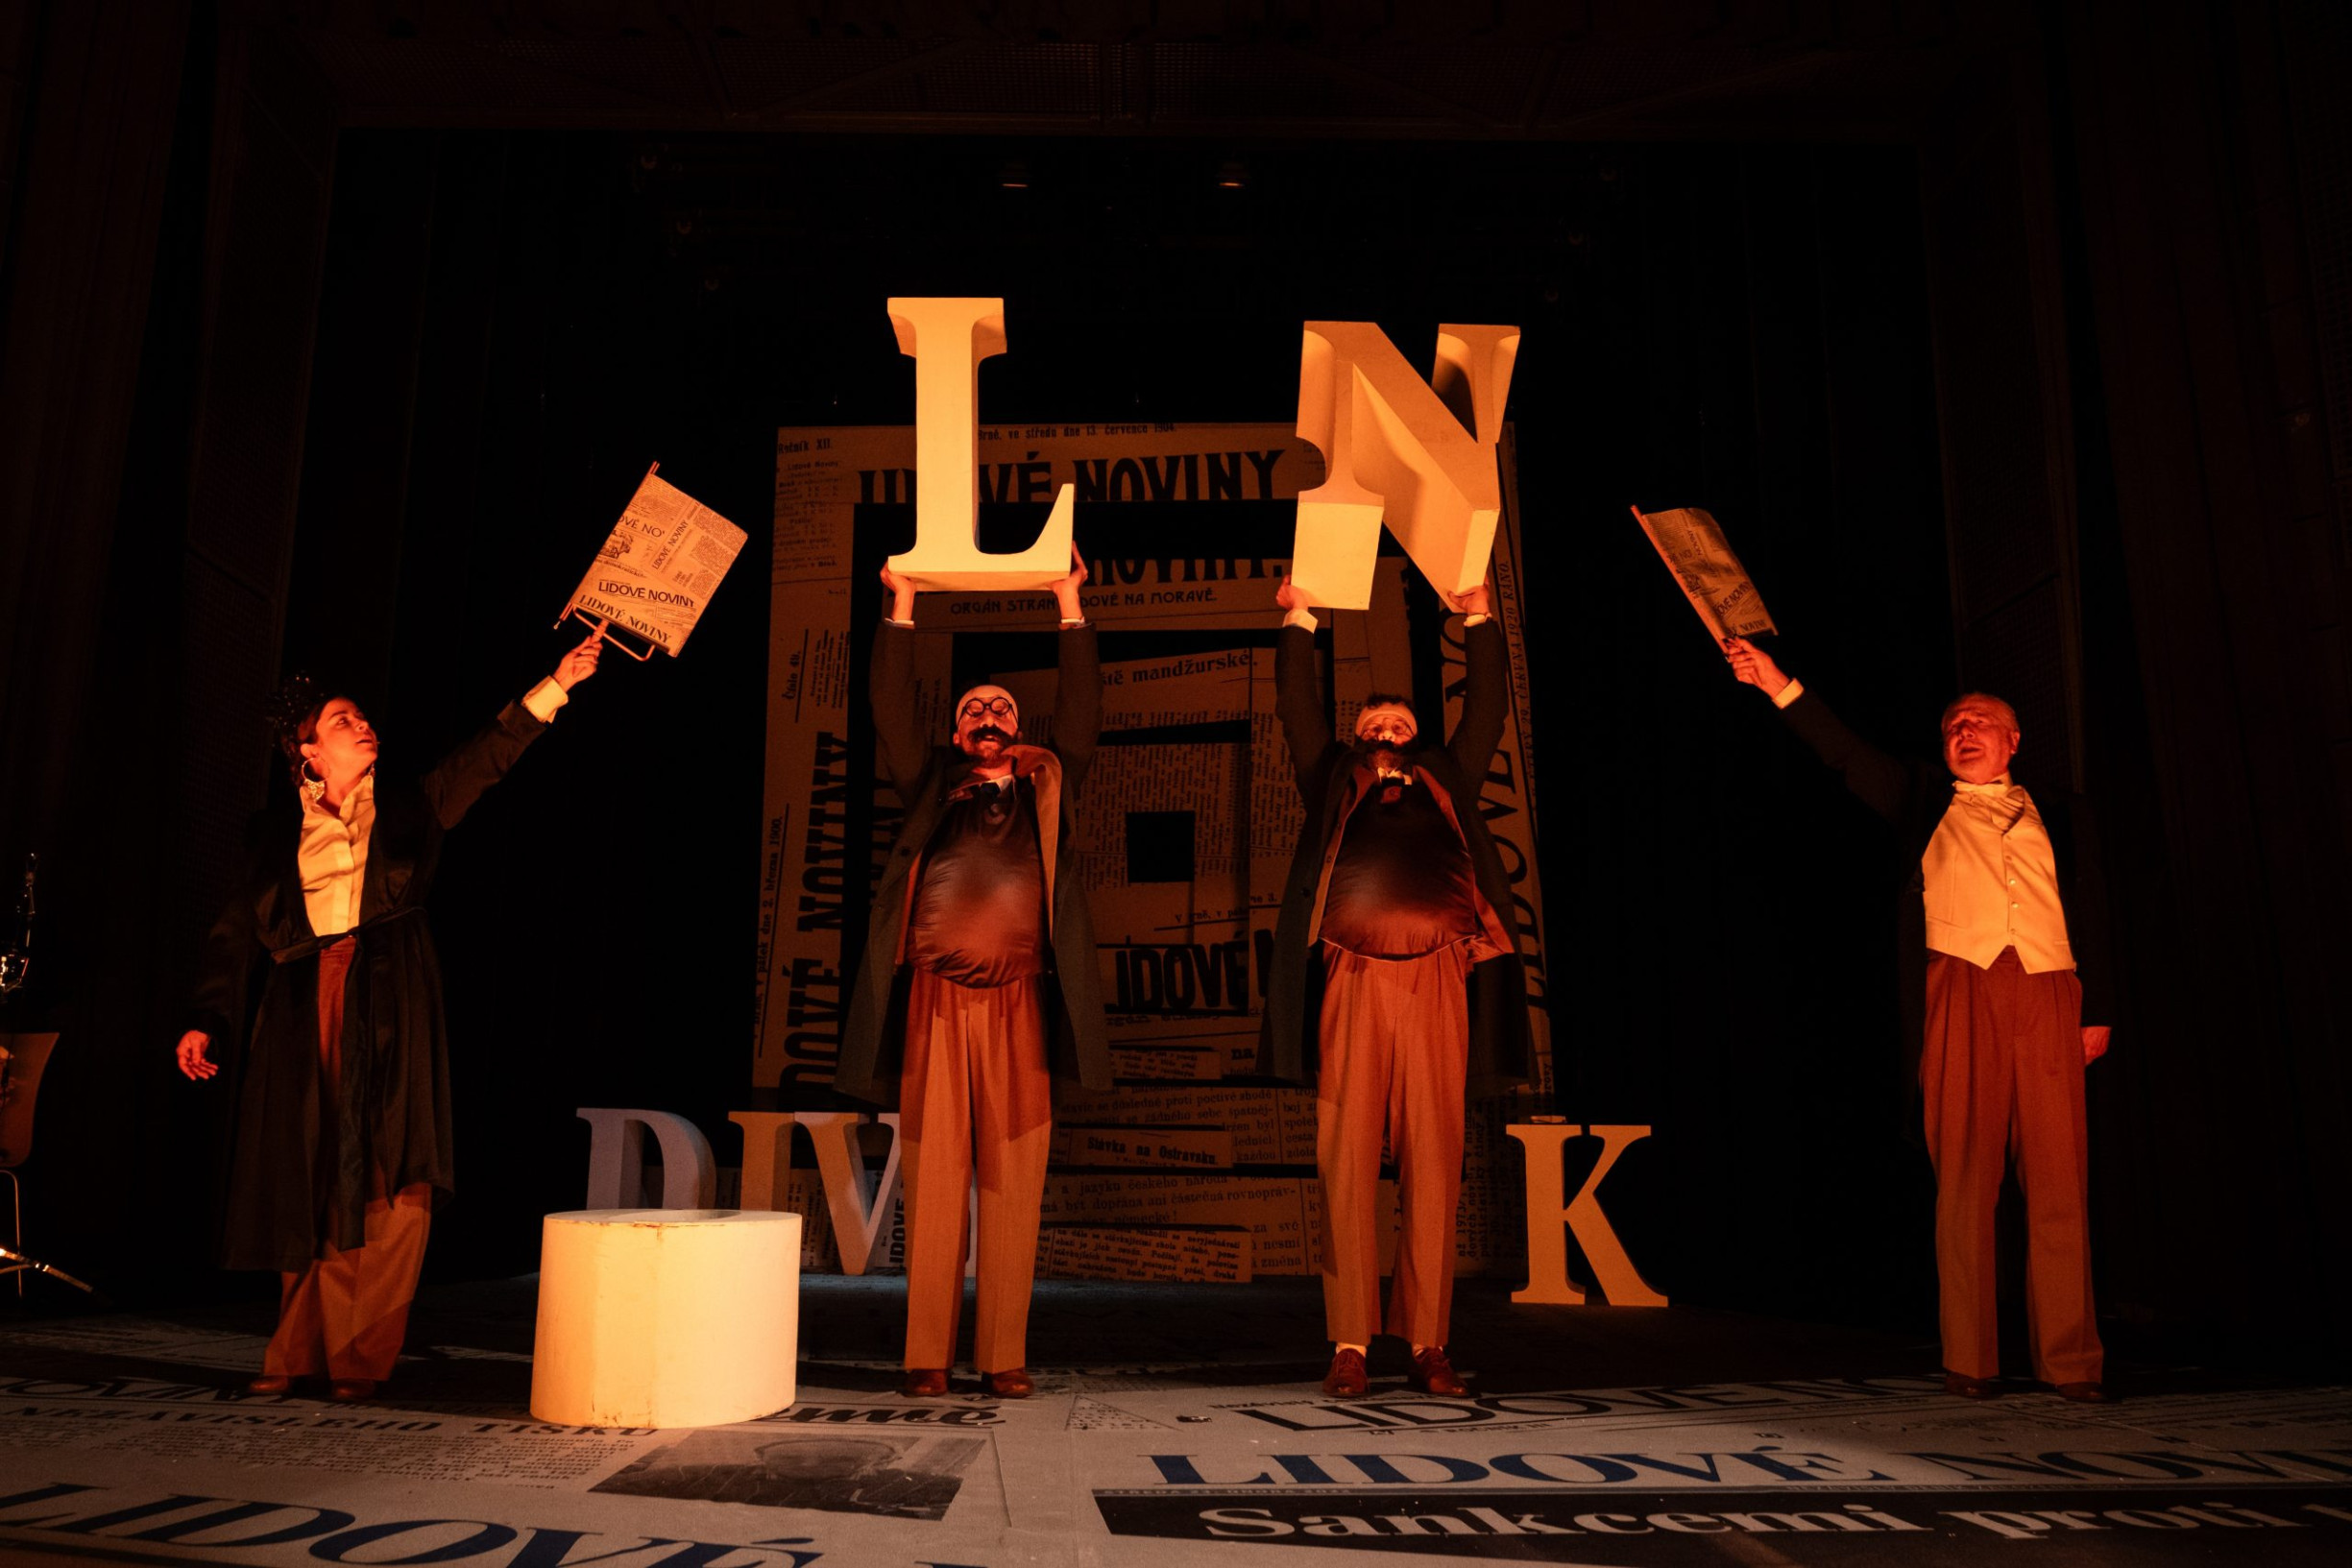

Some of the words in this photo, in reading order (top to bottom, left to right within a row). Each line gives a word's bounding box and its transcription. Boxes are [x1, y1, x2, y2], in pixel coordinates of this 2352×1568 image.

[1063, 426, 1080, 437] dne
[648, 589, 694, 608] NOVINY
[1125, 592, 1144, 605] NA
[626, 615, 672, 643] NOVINY
[1136, 1146, 1151, 1156] na
[1506, 1123, 1669, 1308] K
[1137, 1446, 1898, 1484] LIDOVÉ
[1199, 1504, 1934, 1538] Sankcemi
[1938, 1502, 2309, 1540] proti
